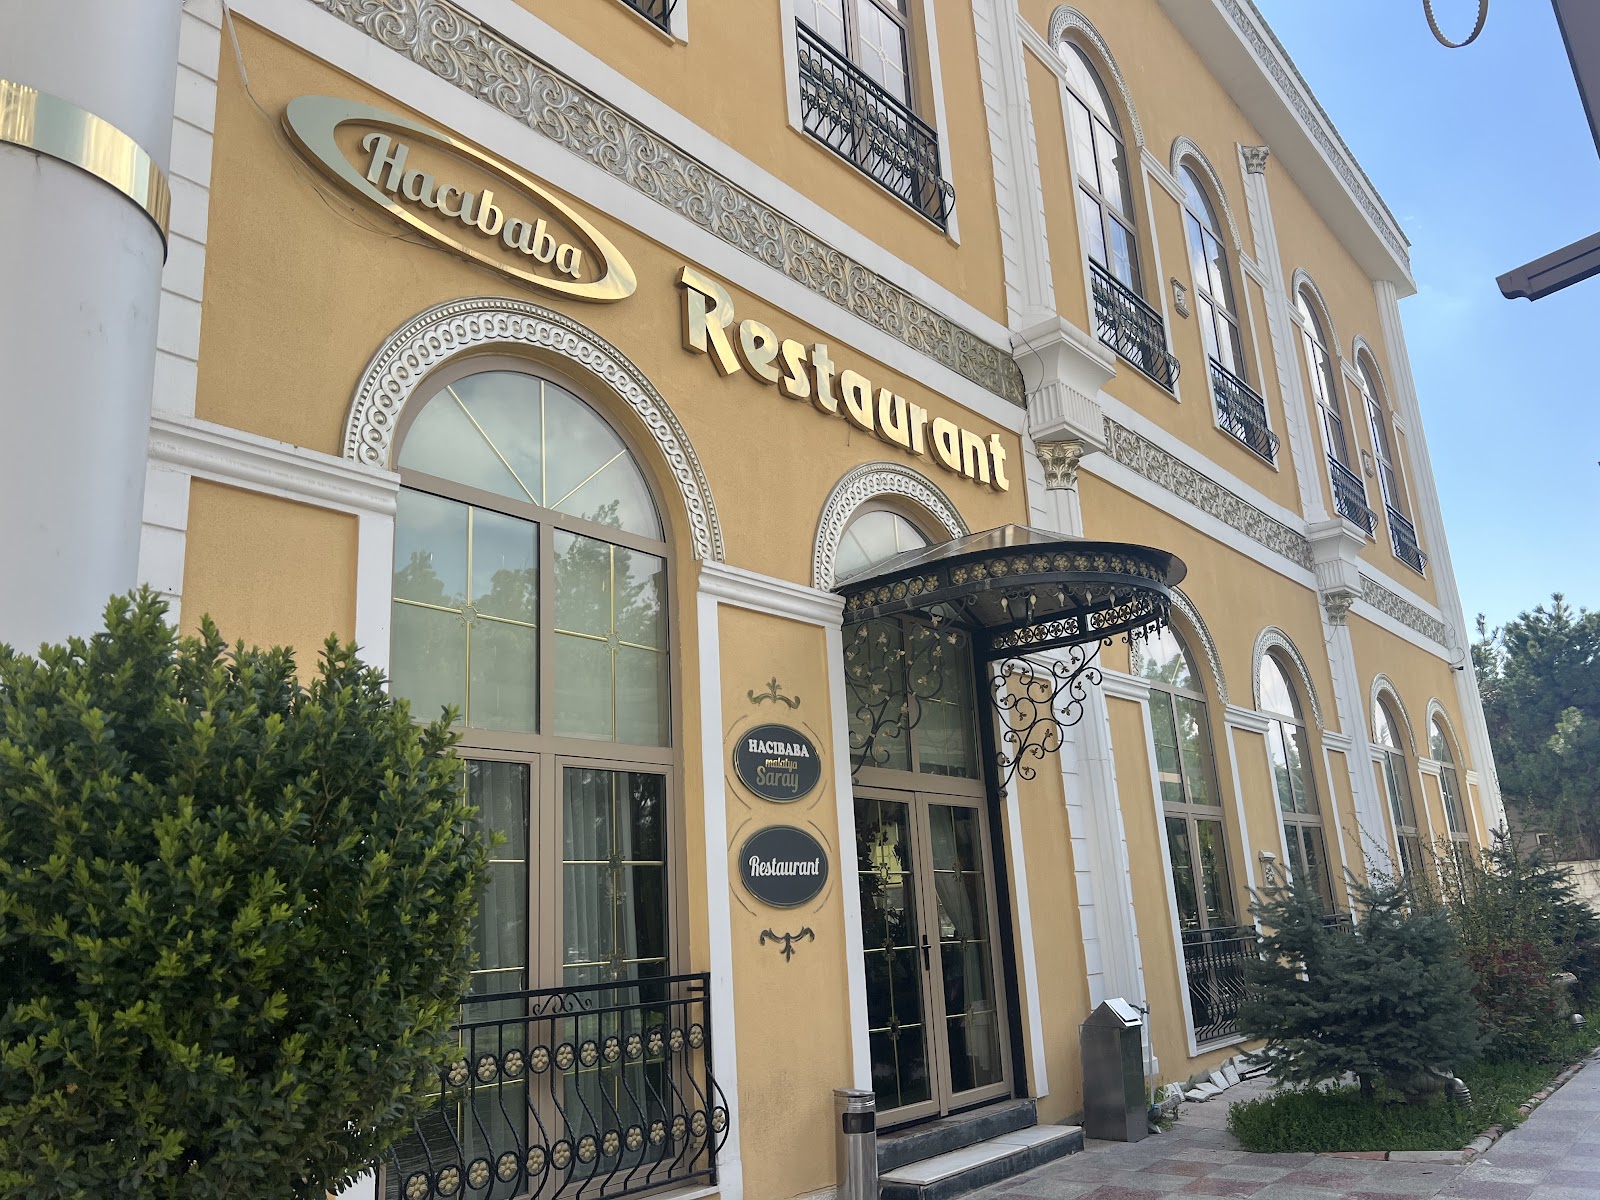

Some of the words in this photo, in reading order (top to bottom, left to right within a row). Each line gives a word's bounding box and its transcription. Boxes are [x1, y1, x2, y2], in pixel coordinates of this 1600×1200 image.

[678, 266, 1010, 492] Restaurant
[748, 739, 809, 757] HACIBABA
[765, 757, 798, 772] malatya
[756, 766, 799, 792] Saray
[749, 855, 819, 876] Restaurant
